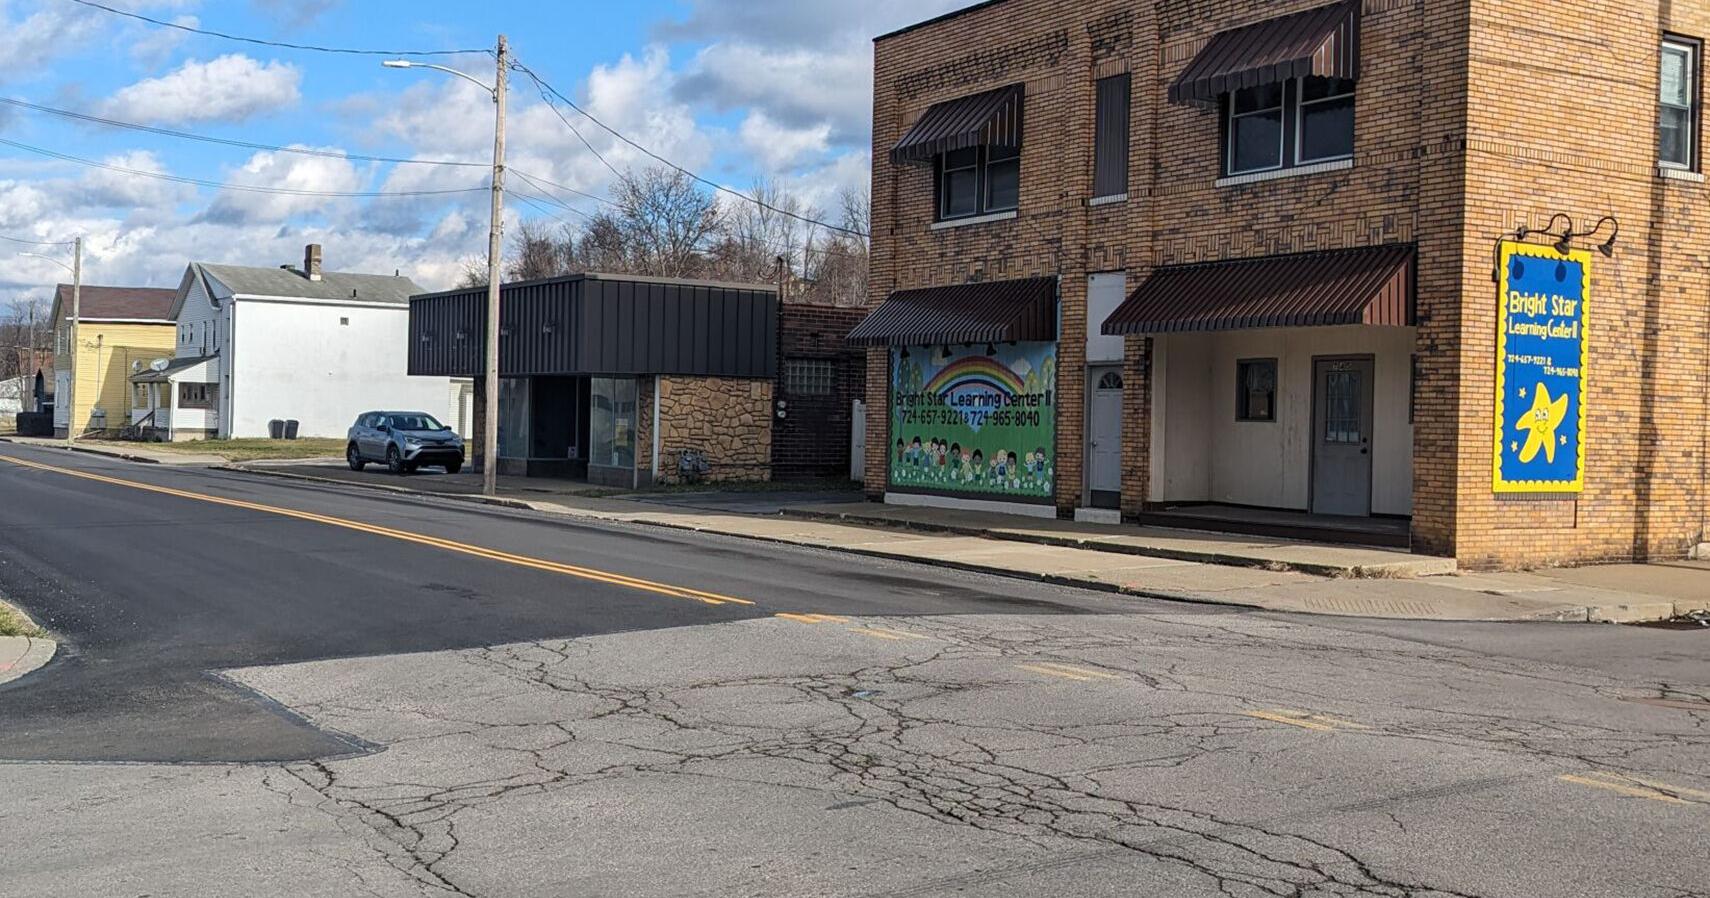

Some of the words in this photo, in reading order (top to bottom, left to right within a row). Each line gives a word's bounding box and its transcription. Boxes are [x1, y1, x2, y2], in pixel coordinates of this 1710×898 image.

[1509, 291, 1547, 317] Bright
[1551, 294, 1578, 317] Star
[1508, 316, 1547, 340] Learning
[1547, 318, 1572, 338] Center
[896, 391, 924, 407] Bright
[927, 392, 948, 406] Star
[950, 391, 1001, 409] Learning
[1004, 391, 1044, 407] Center
